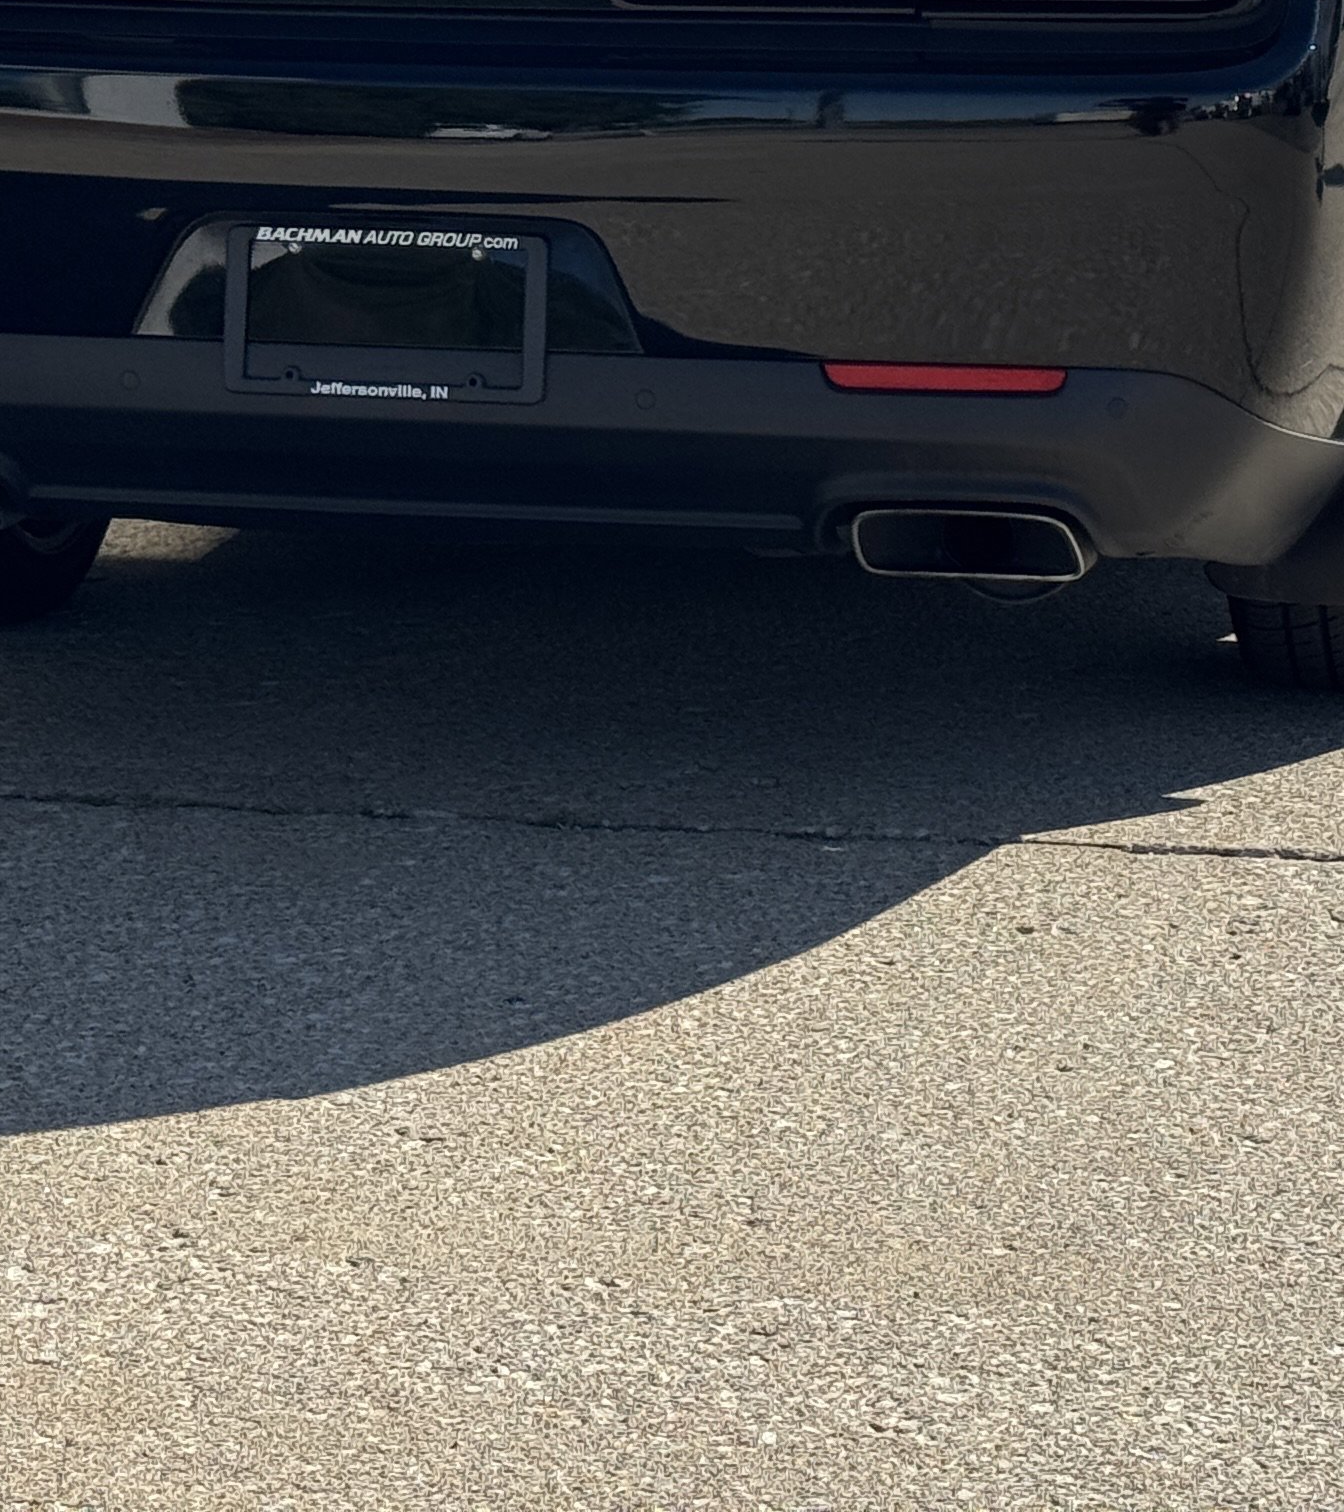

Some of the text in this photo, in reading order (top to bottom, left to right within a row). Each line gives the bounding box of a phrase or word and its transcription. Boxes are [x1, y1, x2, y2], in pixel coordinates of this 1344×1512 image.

[256, 226, 363, 244] BACHMAN
[362, 230, 415, 246] AUTO
[310, 381, 449, 400] Jeffersonville, IN
